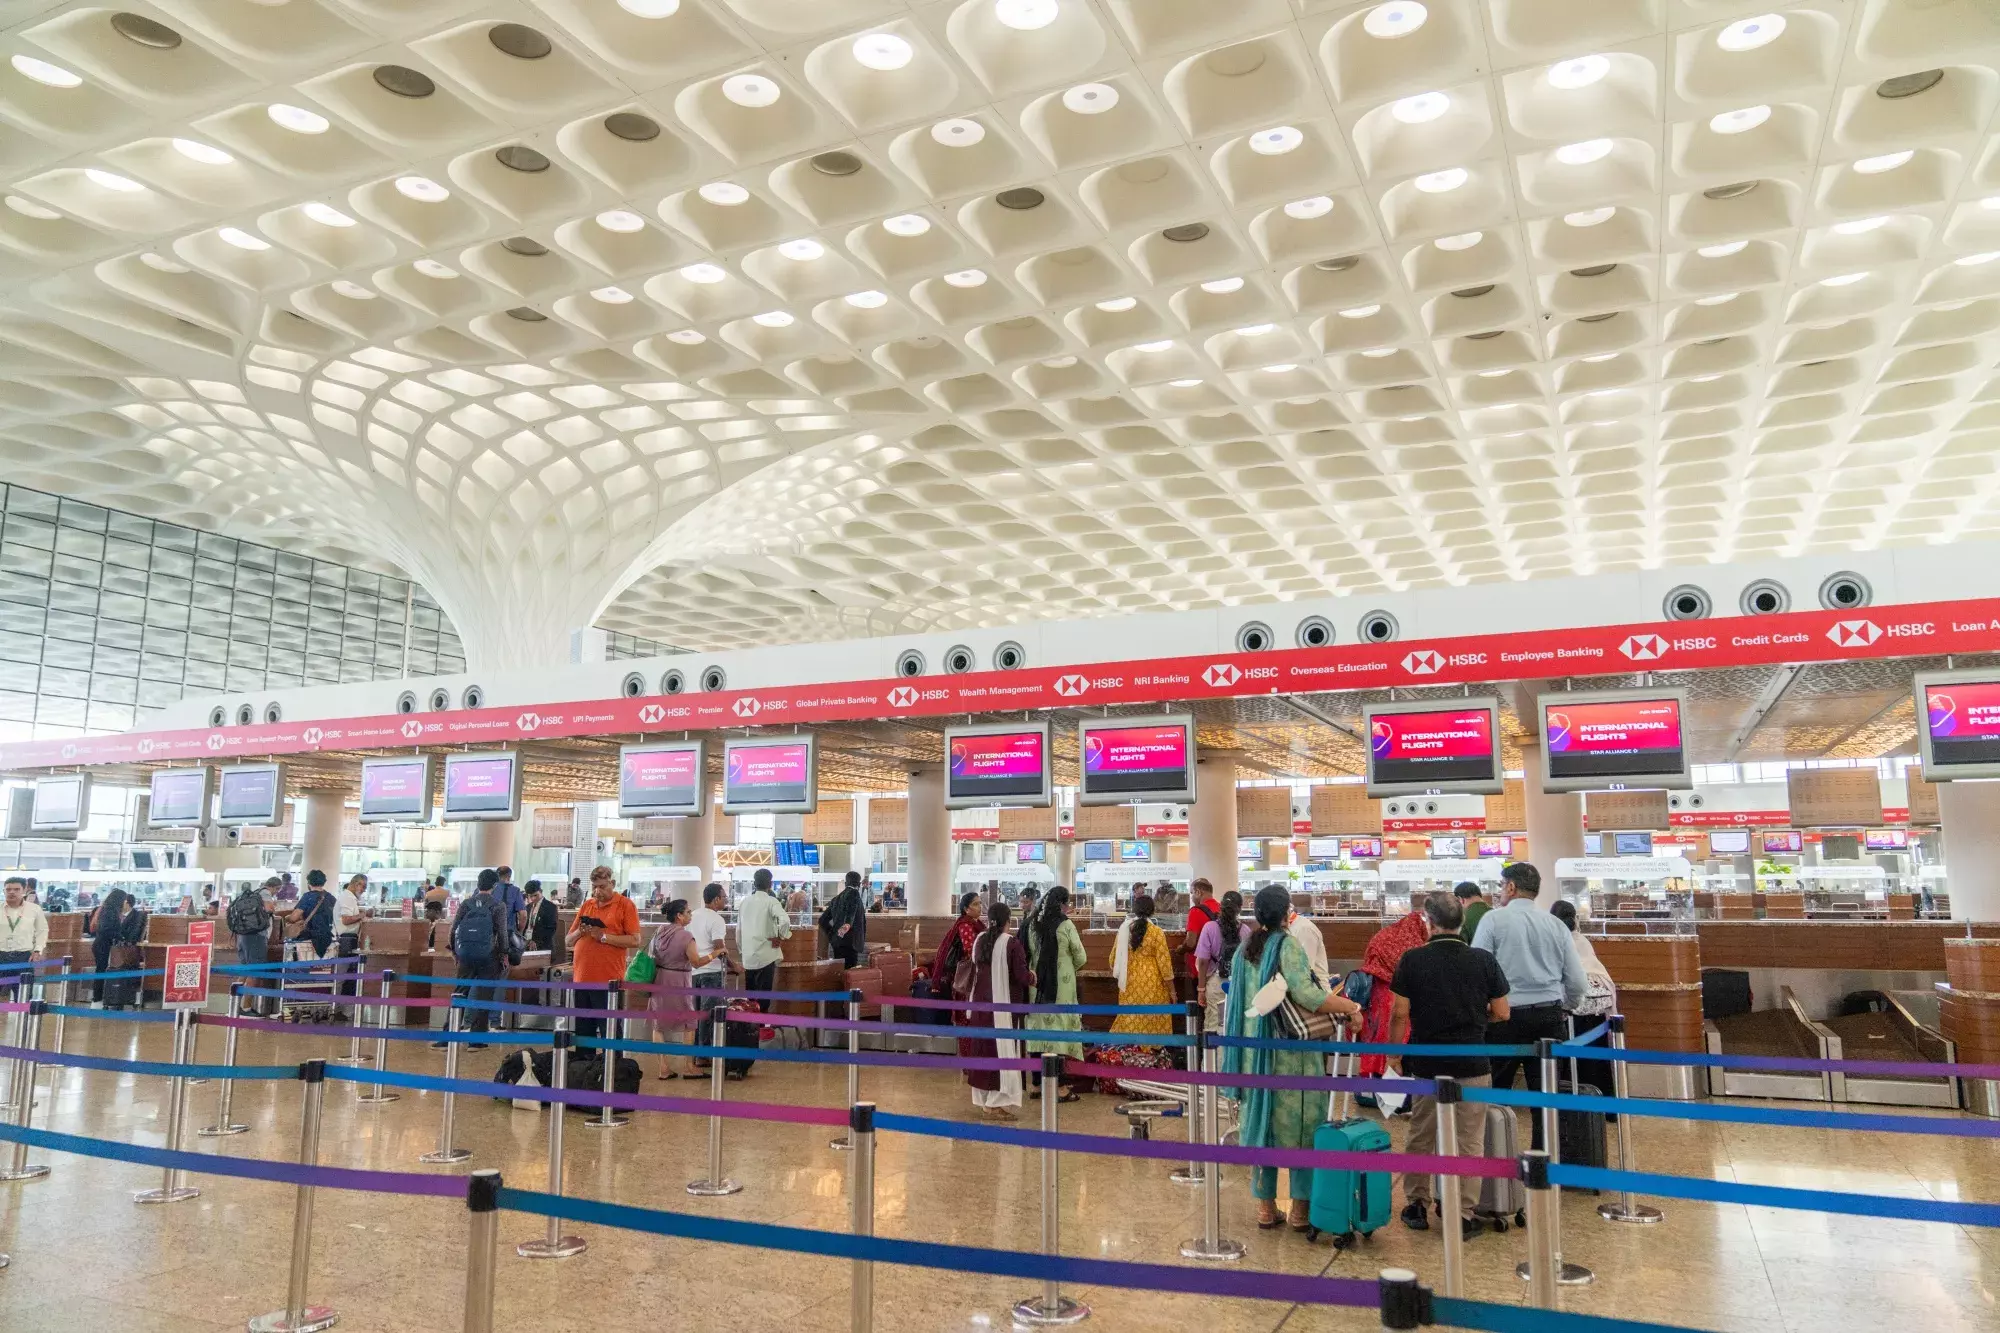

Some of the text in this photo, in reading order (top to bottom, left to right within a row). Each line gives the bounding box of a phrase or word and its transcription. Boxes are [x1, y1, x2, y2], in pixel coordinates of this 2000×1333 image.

[1886, 622, 1936, 638] HSBC
[1951, 622, 1987, 632] Loan
[1673, 632, 1810, 651] HSBC Credit Cards
[1449, 646, 1604, 666] HSBC Employee Banking
[1244, 661, 1388, 679] HSBC Overseas Education
[1092, 674, 1190, 689] HSBC NRI Banking
[921, 684, 1043, 700] HSBC Wealth Management
[762, 694, 878, 711] HSBC Global Private Banking
[667, 705, 724, 718] HSBC Premier
[1967, 706, 2000, 715] INTE
[542, 713, 615, 726] HSBC UPI Payments
[1969, 716, 2000, 725] FLIG
[424, 722, 444, 733] HSBC
[449, 721, 468, 731] Digital
[467, 720, 492, 729] Personal
[1580, 722, 1669, 732] INTERNATIONAL
[324, 730, 343, 739] HSBC
[1401, 730, 1480, 741] INTERNATIONAL
[1580, 732, 1627, 742] FLIGHTS
[225, 736, 243, 745] HSBC
[1401, 741, 1444, 750] FLIGHTS
[1110, 744, 1177, 754] INTERNATIONAL
[973, 751, 1034, 760] INTERNATIONAL
[1110, 754, 1146, 762] FLIGHTS
[641, 766, 689, 774] INTERNATIONAL
[747, 761, 799, 770] INTERNATIONAL
[747, 769, 775, 777] FLIGHTS
